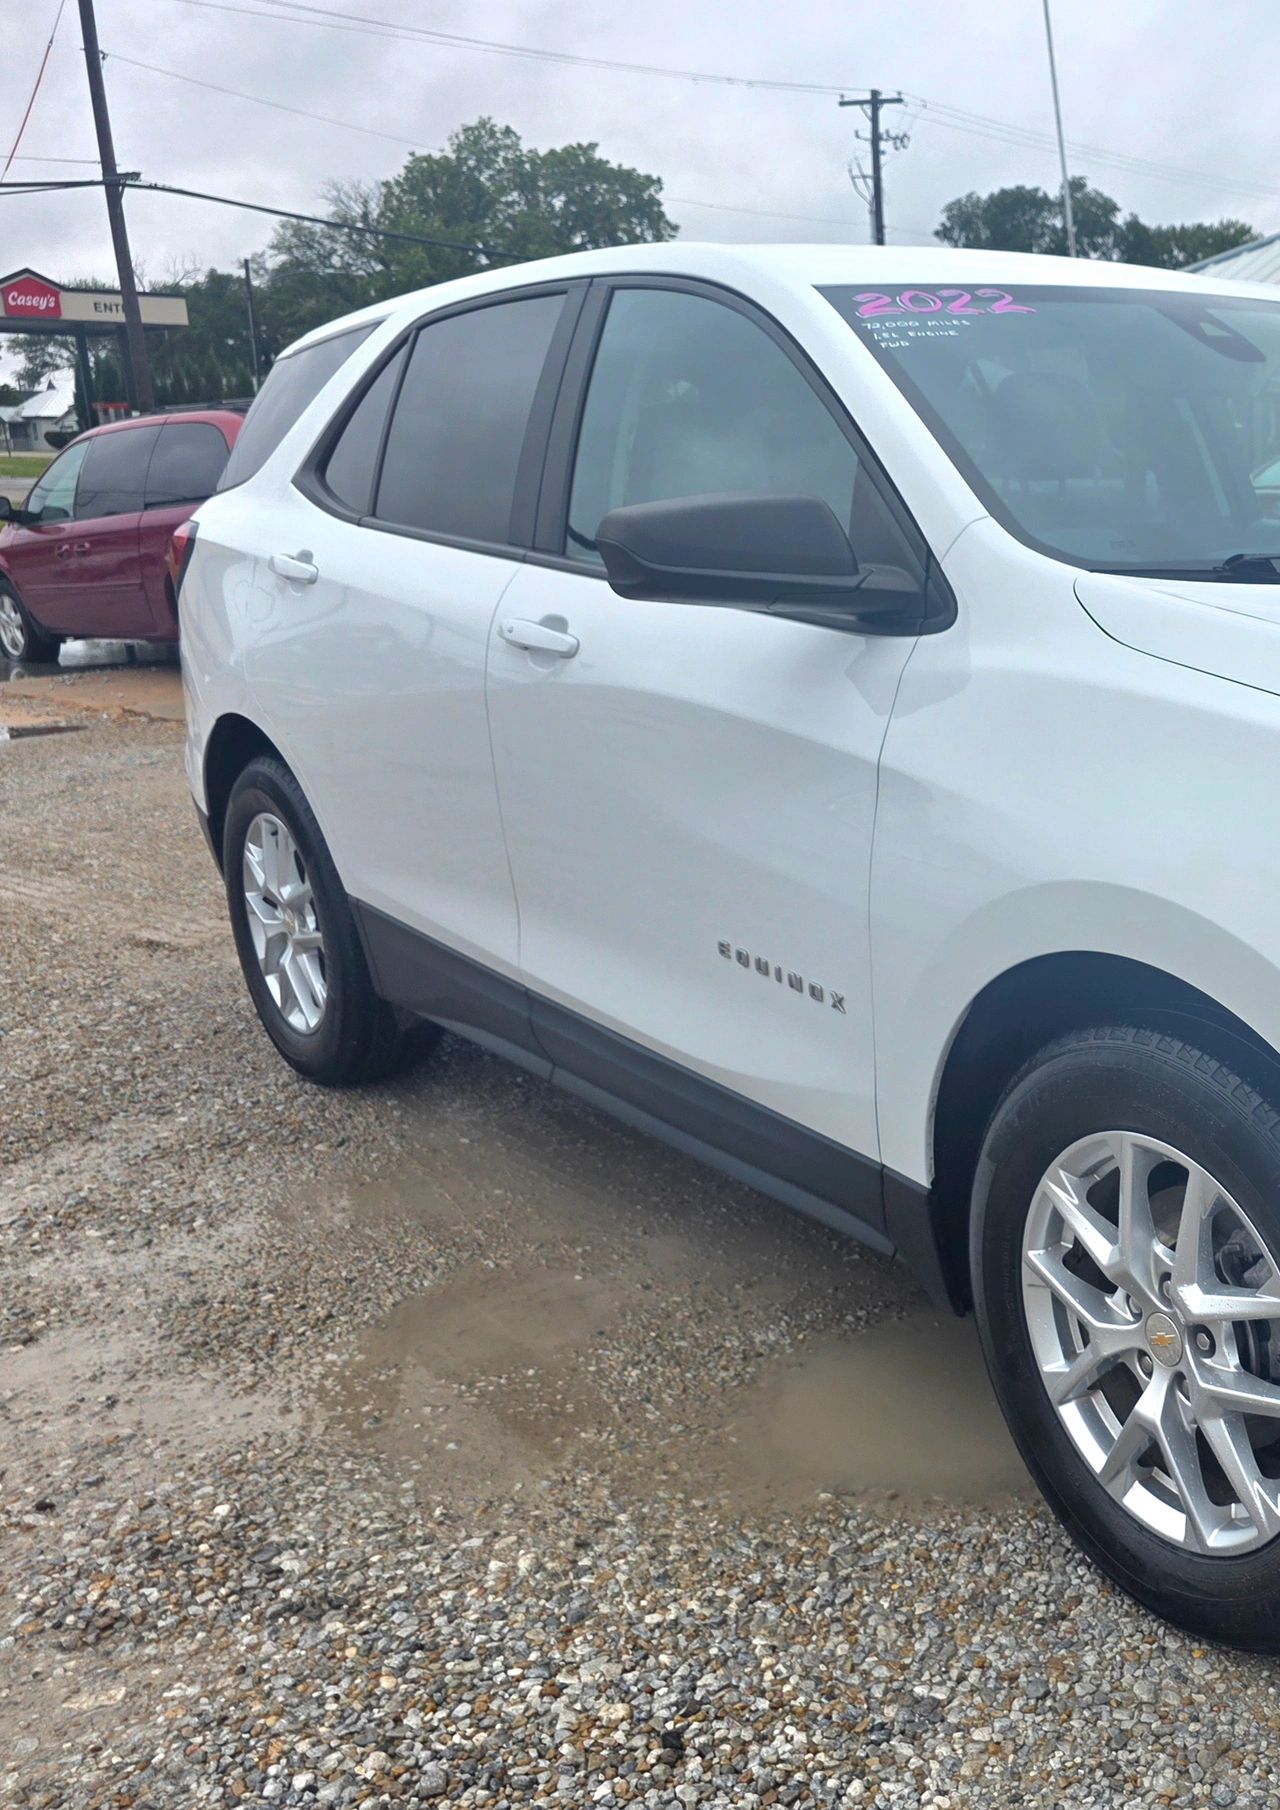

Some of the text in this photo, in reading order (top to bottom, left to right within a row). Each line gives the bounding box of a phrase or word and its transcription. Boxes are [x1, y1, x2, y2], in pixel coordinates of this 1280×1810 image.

[8, 291, 55, 310] Casey's
[852, 288, 1037, 318] 2022
[927, 319, 971, 328] MILES
[718, 938, 846, 1014] EQUINOX
